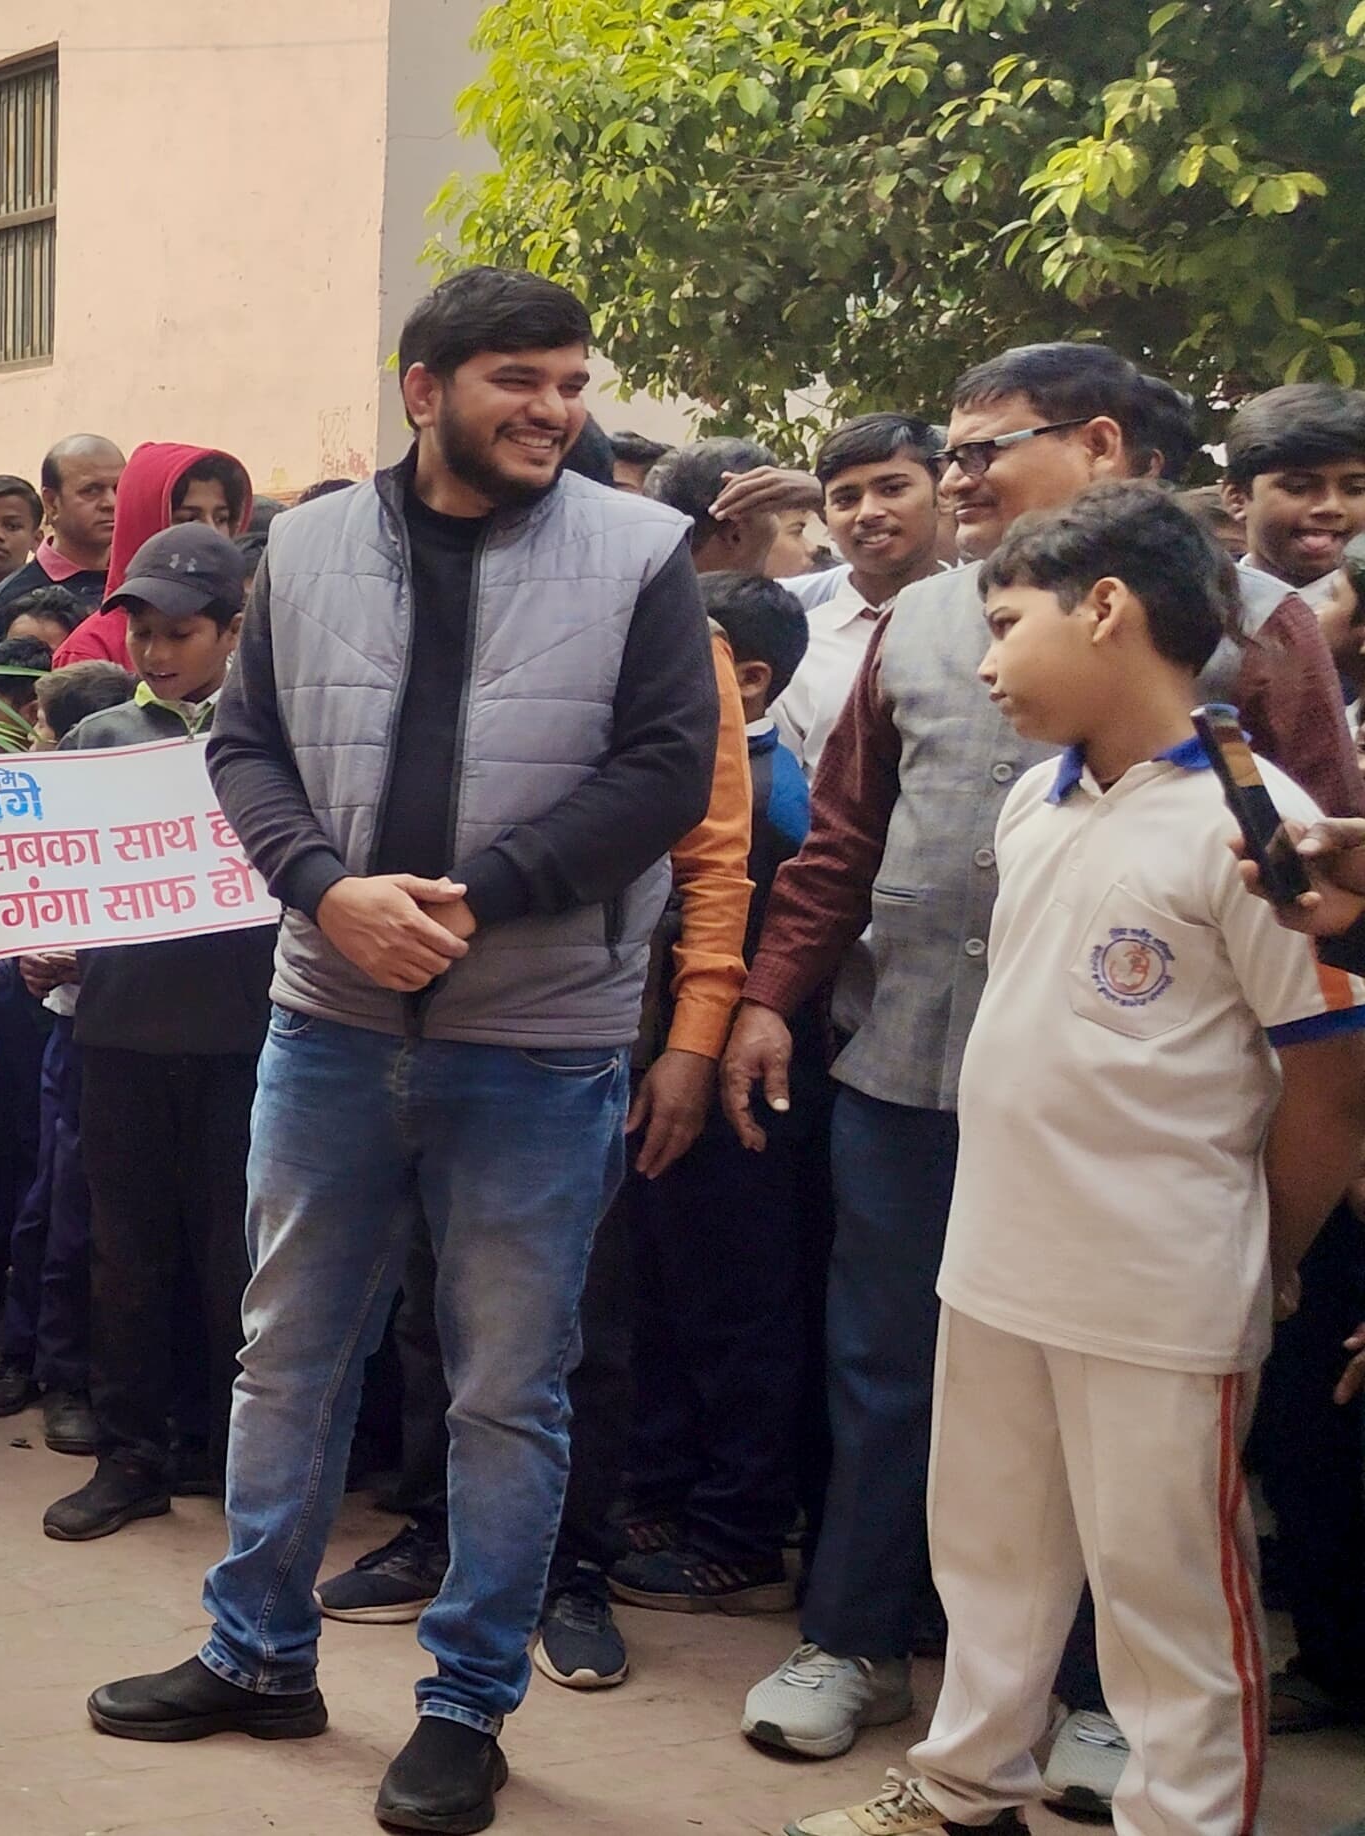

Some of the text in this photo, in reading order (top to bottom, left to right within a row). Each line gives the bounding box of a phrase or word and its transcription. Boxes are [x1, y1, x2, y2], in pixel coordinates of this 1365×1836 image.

[109, 816, 197, 861] साथ
[99, 875, 197, 922] साफ
[207, 856, 257, 908] हो
